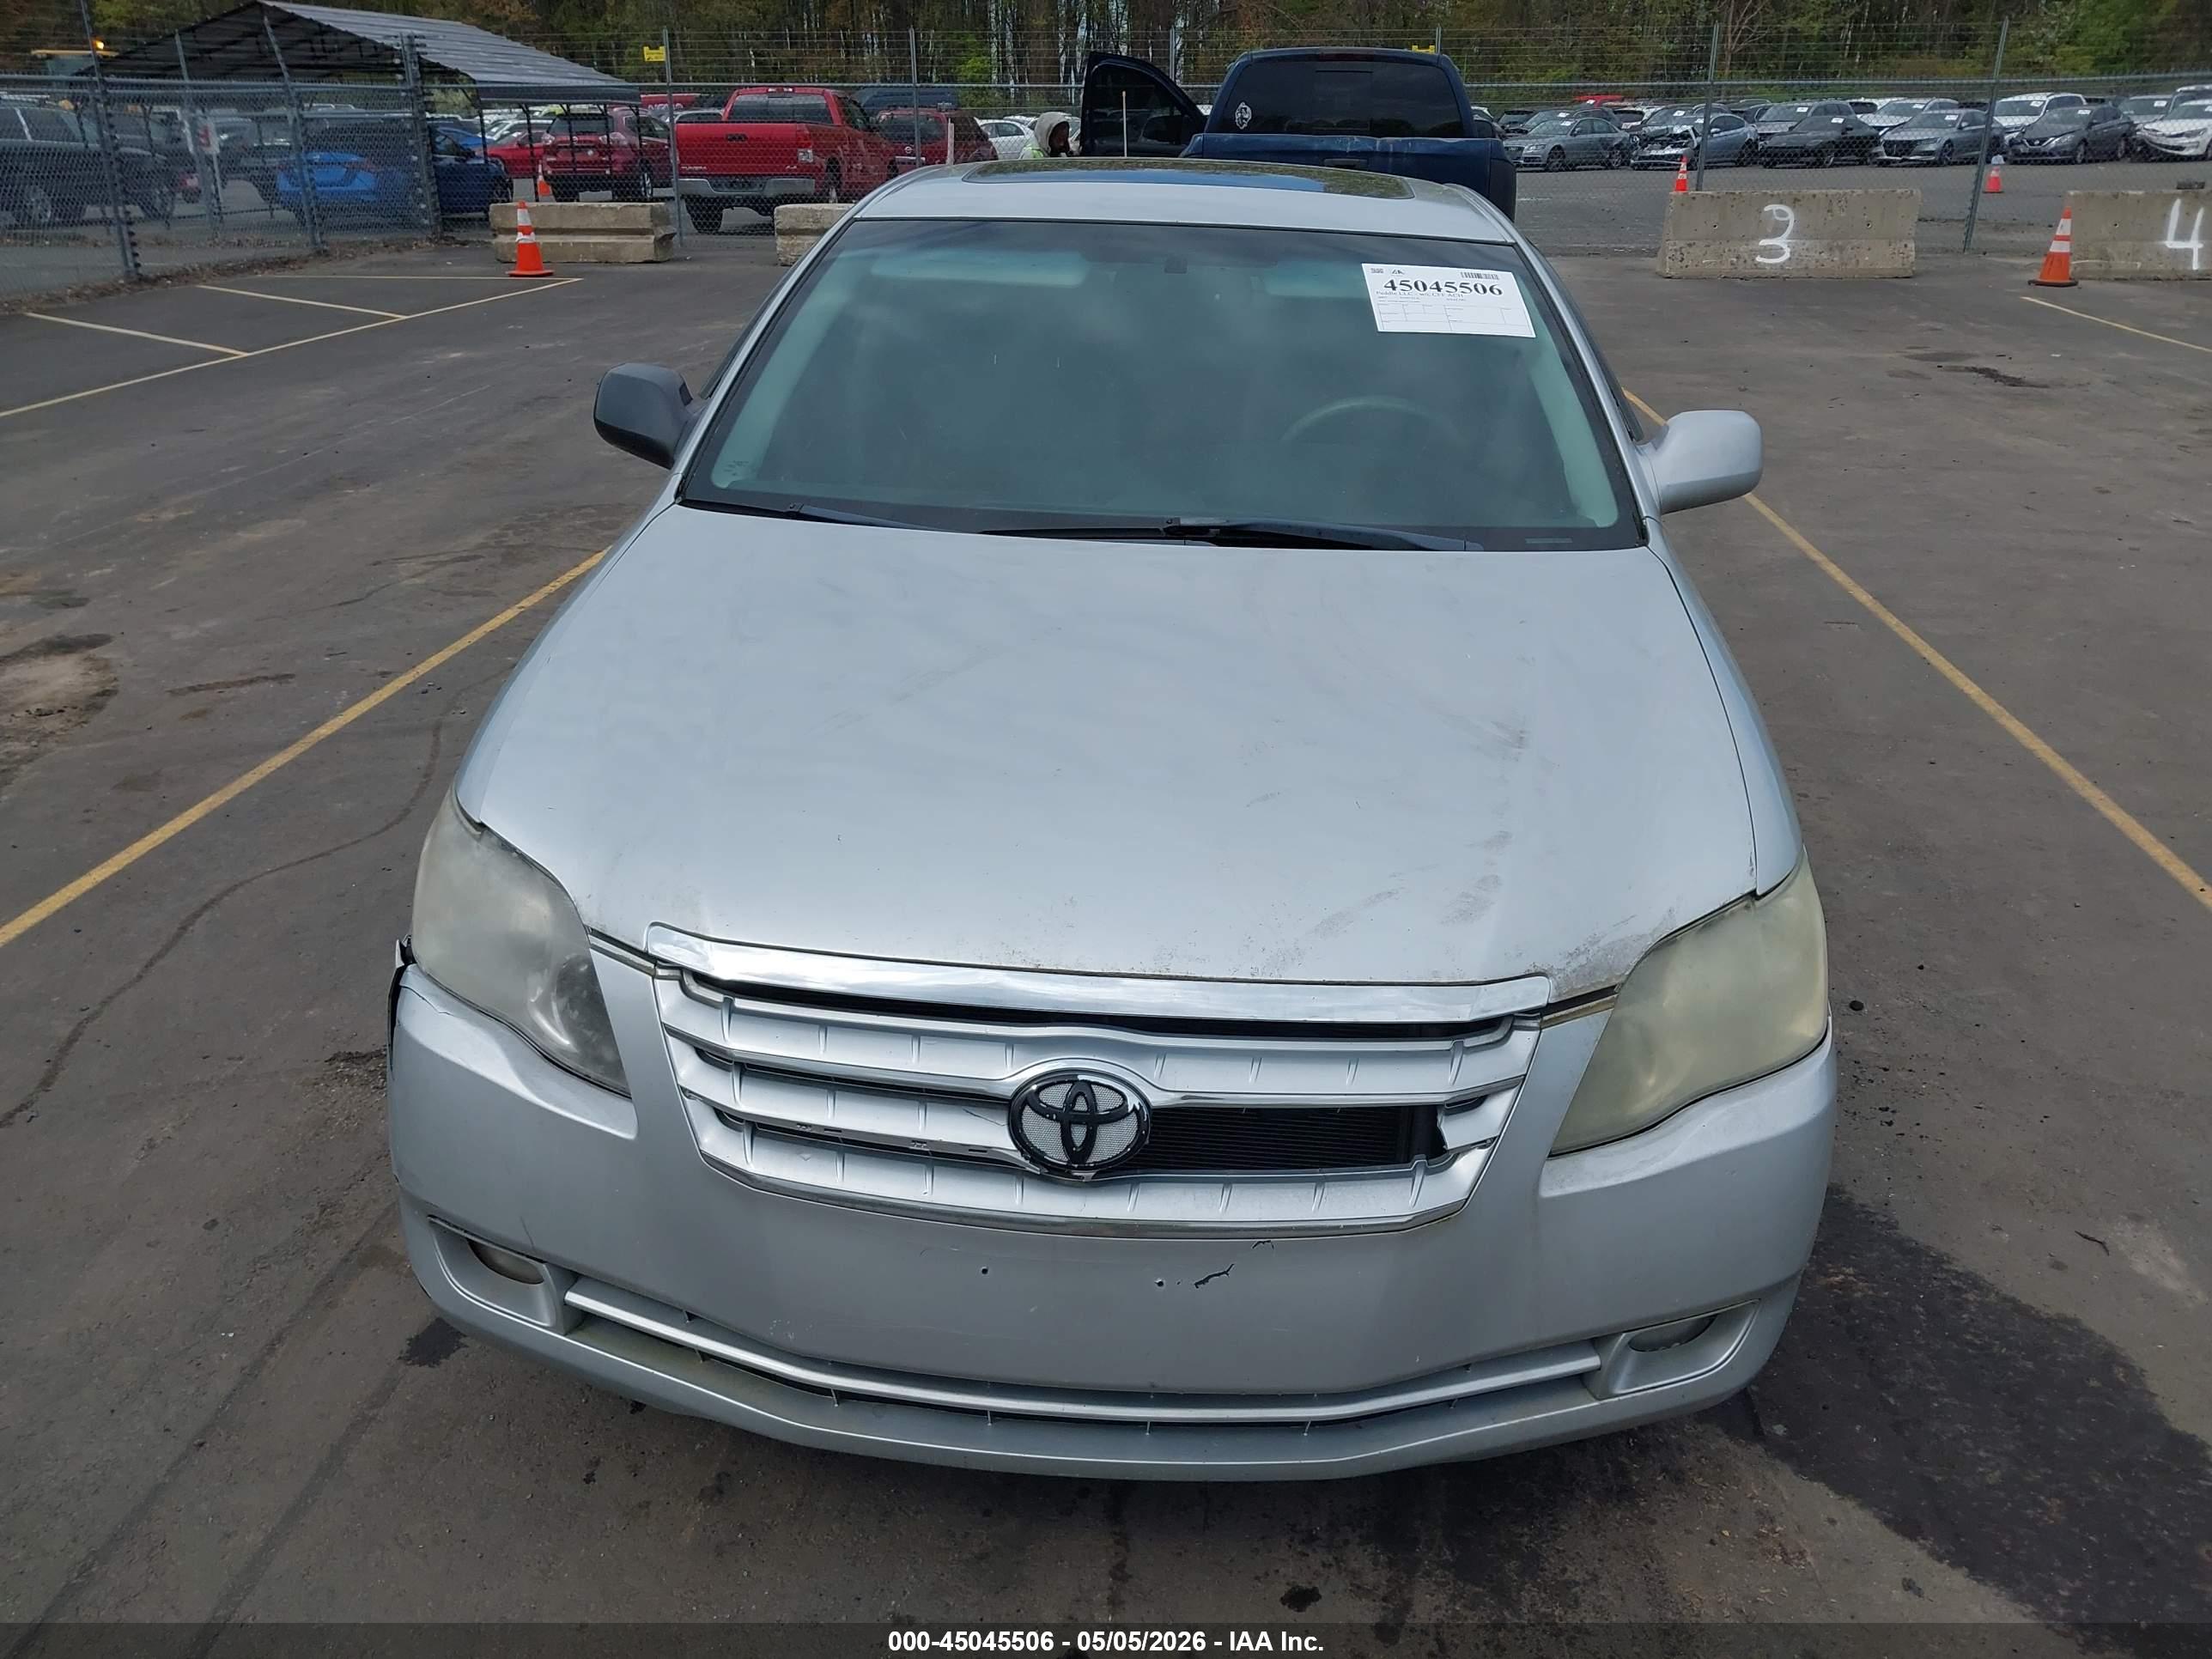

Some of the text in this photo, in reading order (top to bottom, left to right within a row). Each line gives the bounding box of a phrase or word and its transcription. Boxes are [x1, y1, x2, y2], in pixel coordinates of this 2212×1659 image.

[1756, 204, 1795, 263] 3
[2164, 198, 2204, 270] 4
[1383, 279, 1504, 296] 45045506
